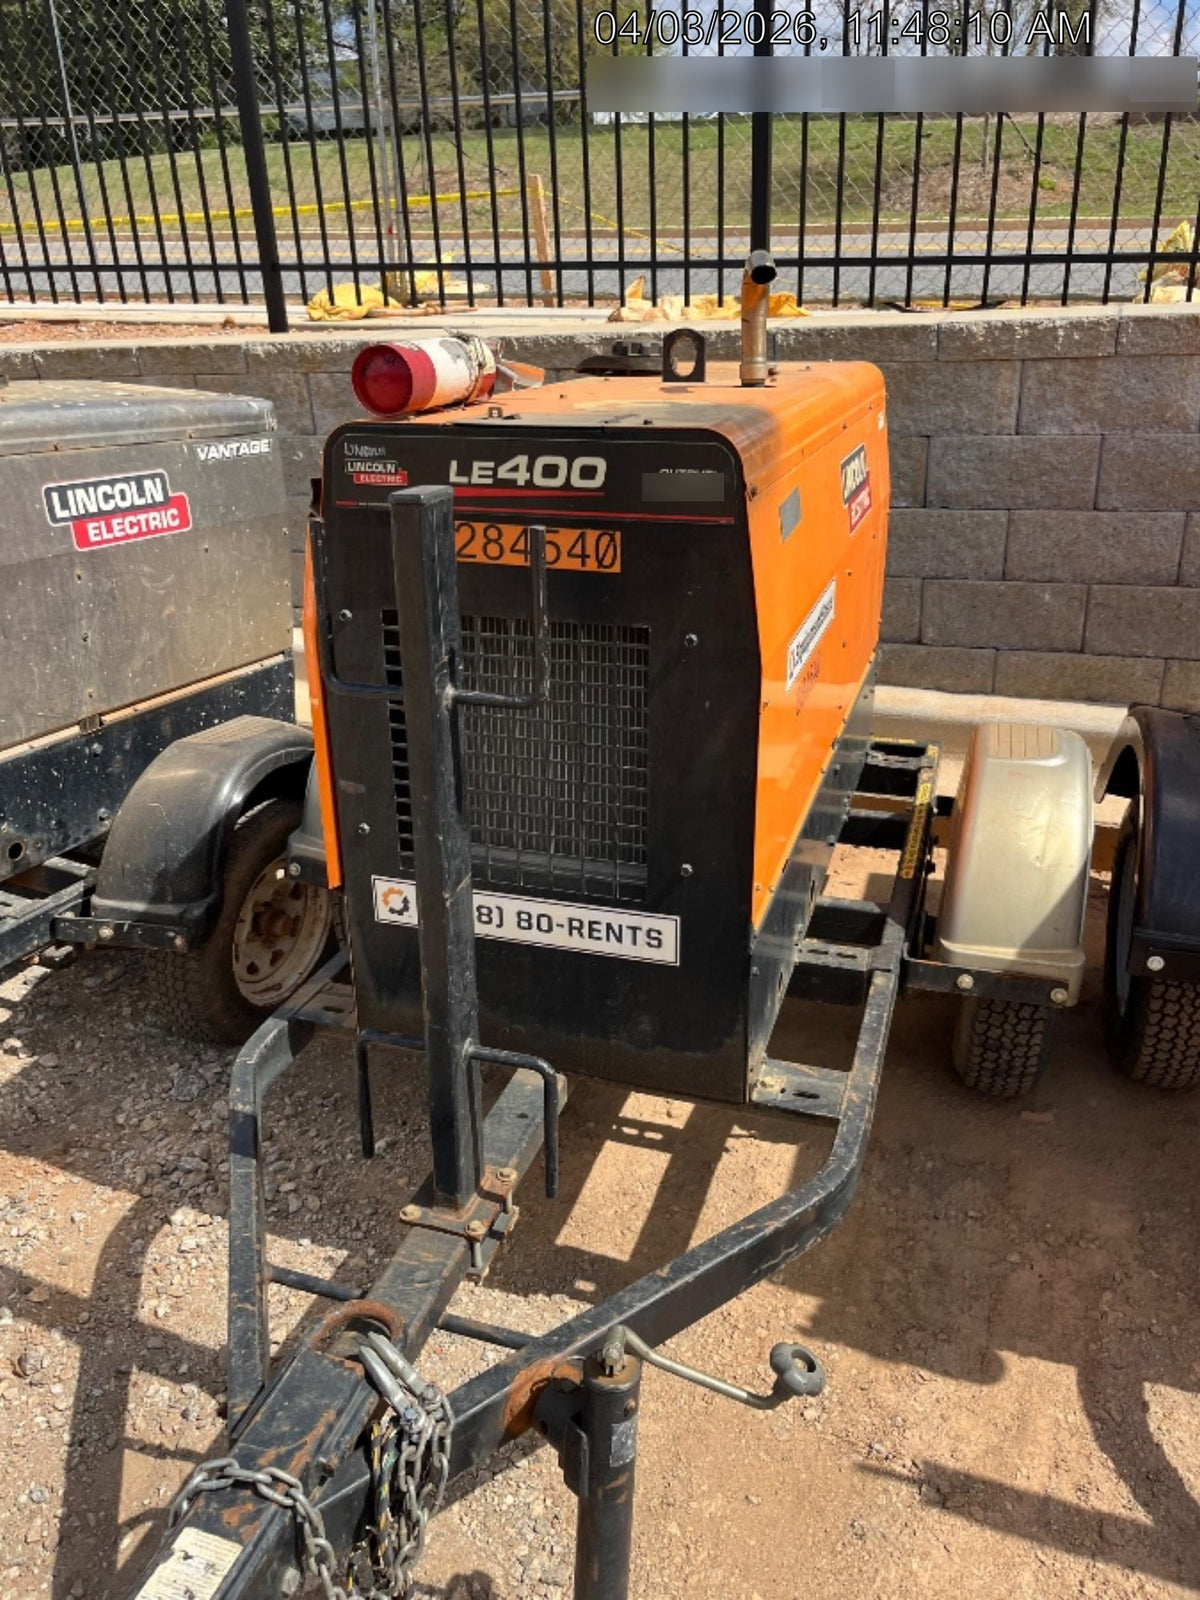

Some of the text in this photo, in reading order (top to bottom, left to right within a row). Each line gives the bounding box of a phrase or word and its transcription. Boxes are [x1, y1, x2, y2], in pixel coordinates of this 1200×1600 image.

[196, 438, 272, 461] VANTAGE
[347, 461, 397, 473] LINCOLN
[360, 474, 403, 484] ELECTRIC
[448, 454, 608, 488] LE400
[50, 477, 165, 519] LINCOLN
[86, 507, 181, 543] ELECTRIC
[476, 904, 663, 949] 8) 80-RENTS
